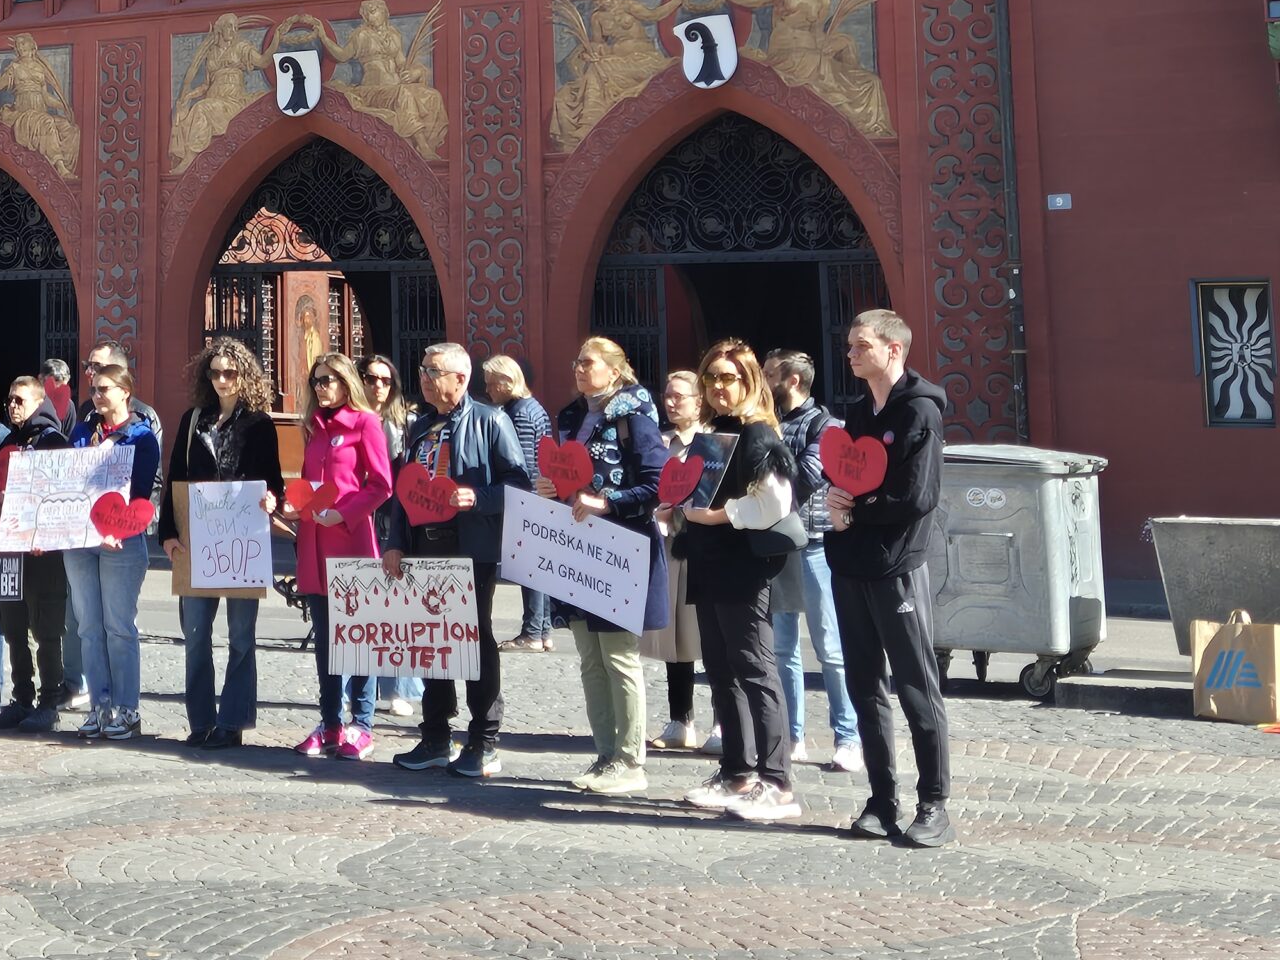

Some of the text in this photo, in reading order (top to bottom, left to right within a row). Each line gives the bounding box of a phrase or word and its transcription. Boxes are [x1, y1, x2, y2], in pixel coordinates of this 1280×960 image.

[1056, 197, 1063, 206] 9
[206, 517, 236, 536] СВИ
[522, 520, 631, 573] PODRŠKA NE ZNA
[3, 558, 18, 573] ВАМ
[537, 556, 612, 597] ZA GRANICE
[335, 619, 479, 645] KORRUPTION
[372, 646, 452, 669] TÖTET
